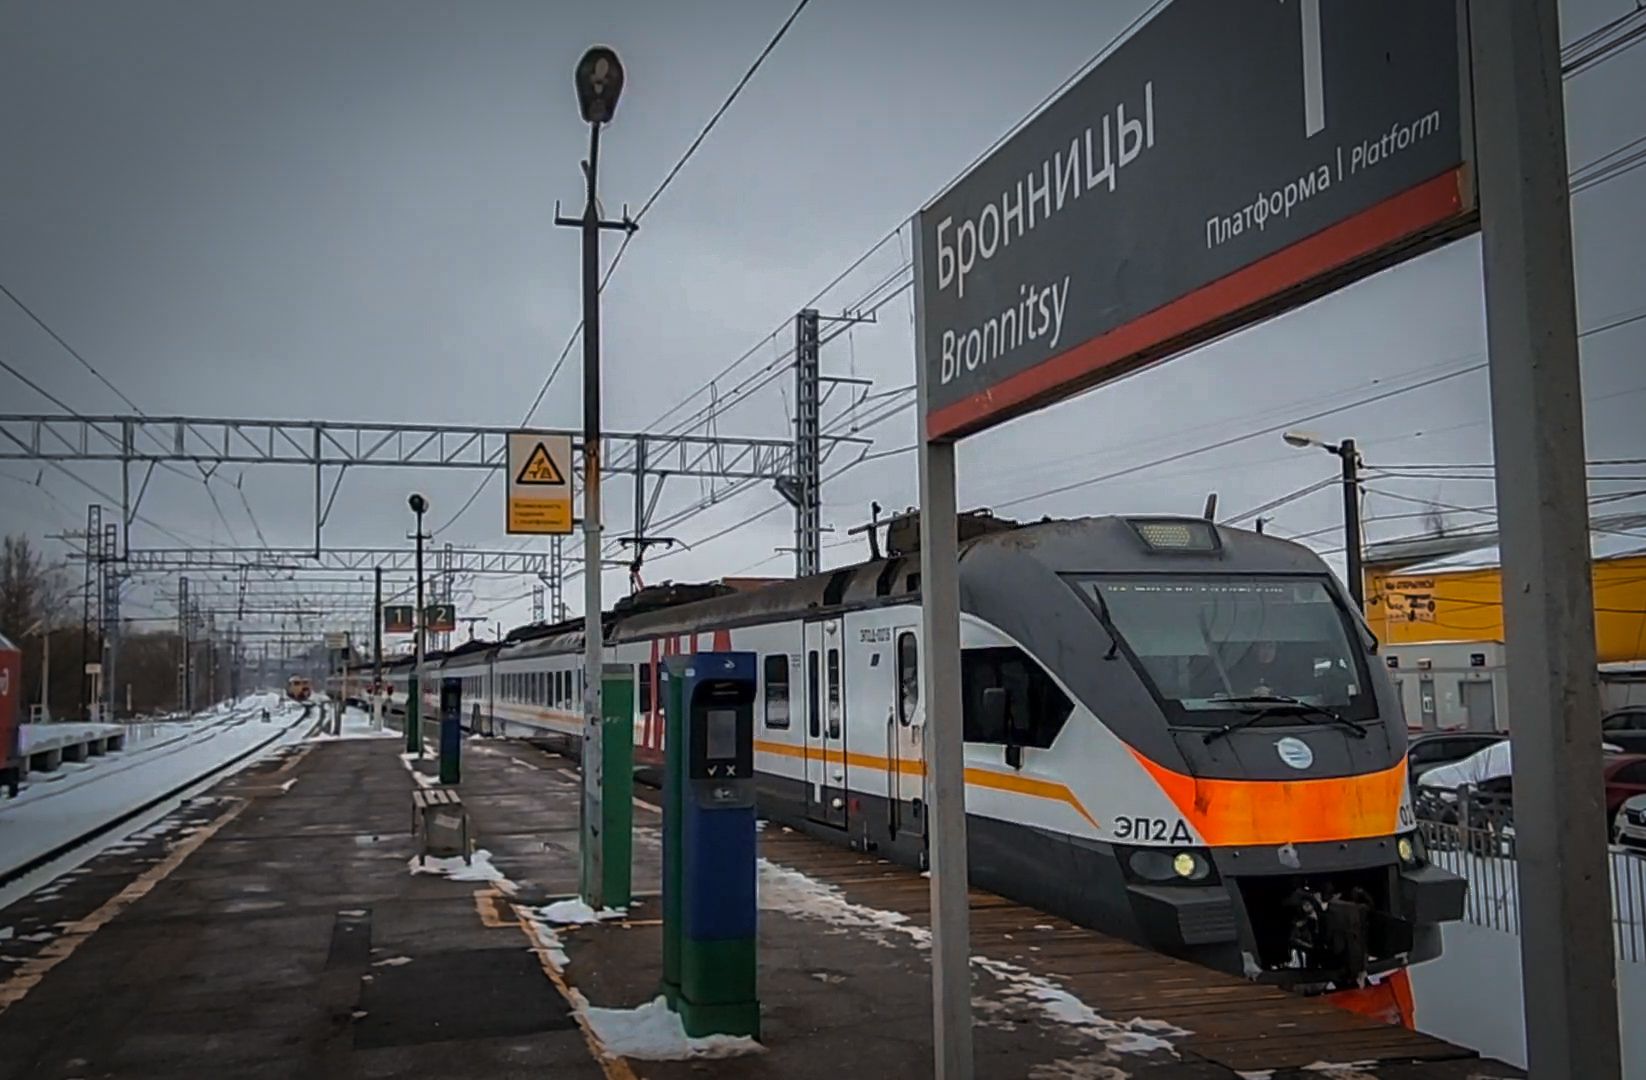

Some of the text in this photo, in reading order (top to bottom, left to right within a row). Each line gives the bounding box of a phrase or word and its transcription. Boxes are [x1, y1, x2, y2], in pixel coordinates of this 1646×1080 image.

[1351, 110, 1439, 175] Platform
[936, 80, 1155, 299] Бронницы
[1206, 164, 1330, 249] Платформа
[940, 275, 1070, 386] Bronnitsy
[394, 608, 402, 624] 1
[436, 607, 447, 622] 2
[1113, 815, 1194, 845] ЭП2Д
